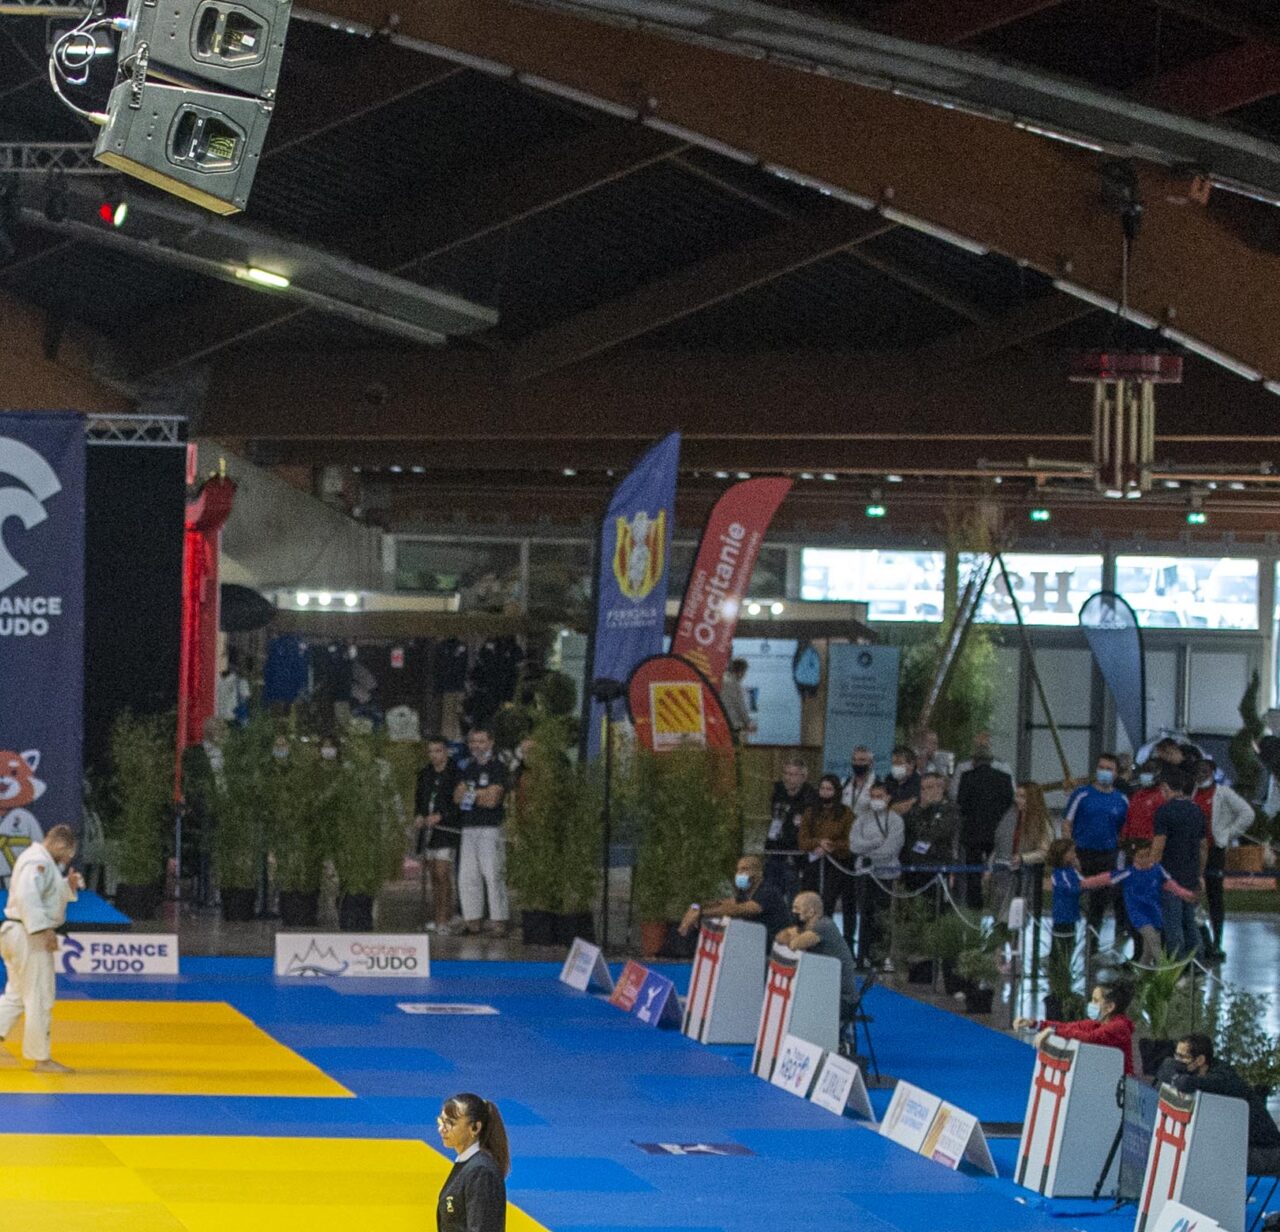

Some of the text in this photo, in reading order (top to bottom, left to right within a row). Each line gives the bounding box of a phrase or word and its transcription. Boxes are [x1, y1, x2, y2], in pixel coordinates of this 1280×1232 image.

[694, 522, 746, 647] Occitanie
[91, 943, 168, 957] FRANCE
[351, 943, 417, 956] Occitanie
[91, 959, 144, 972] JUDO
[367, 956, 417, 970] JUDO
